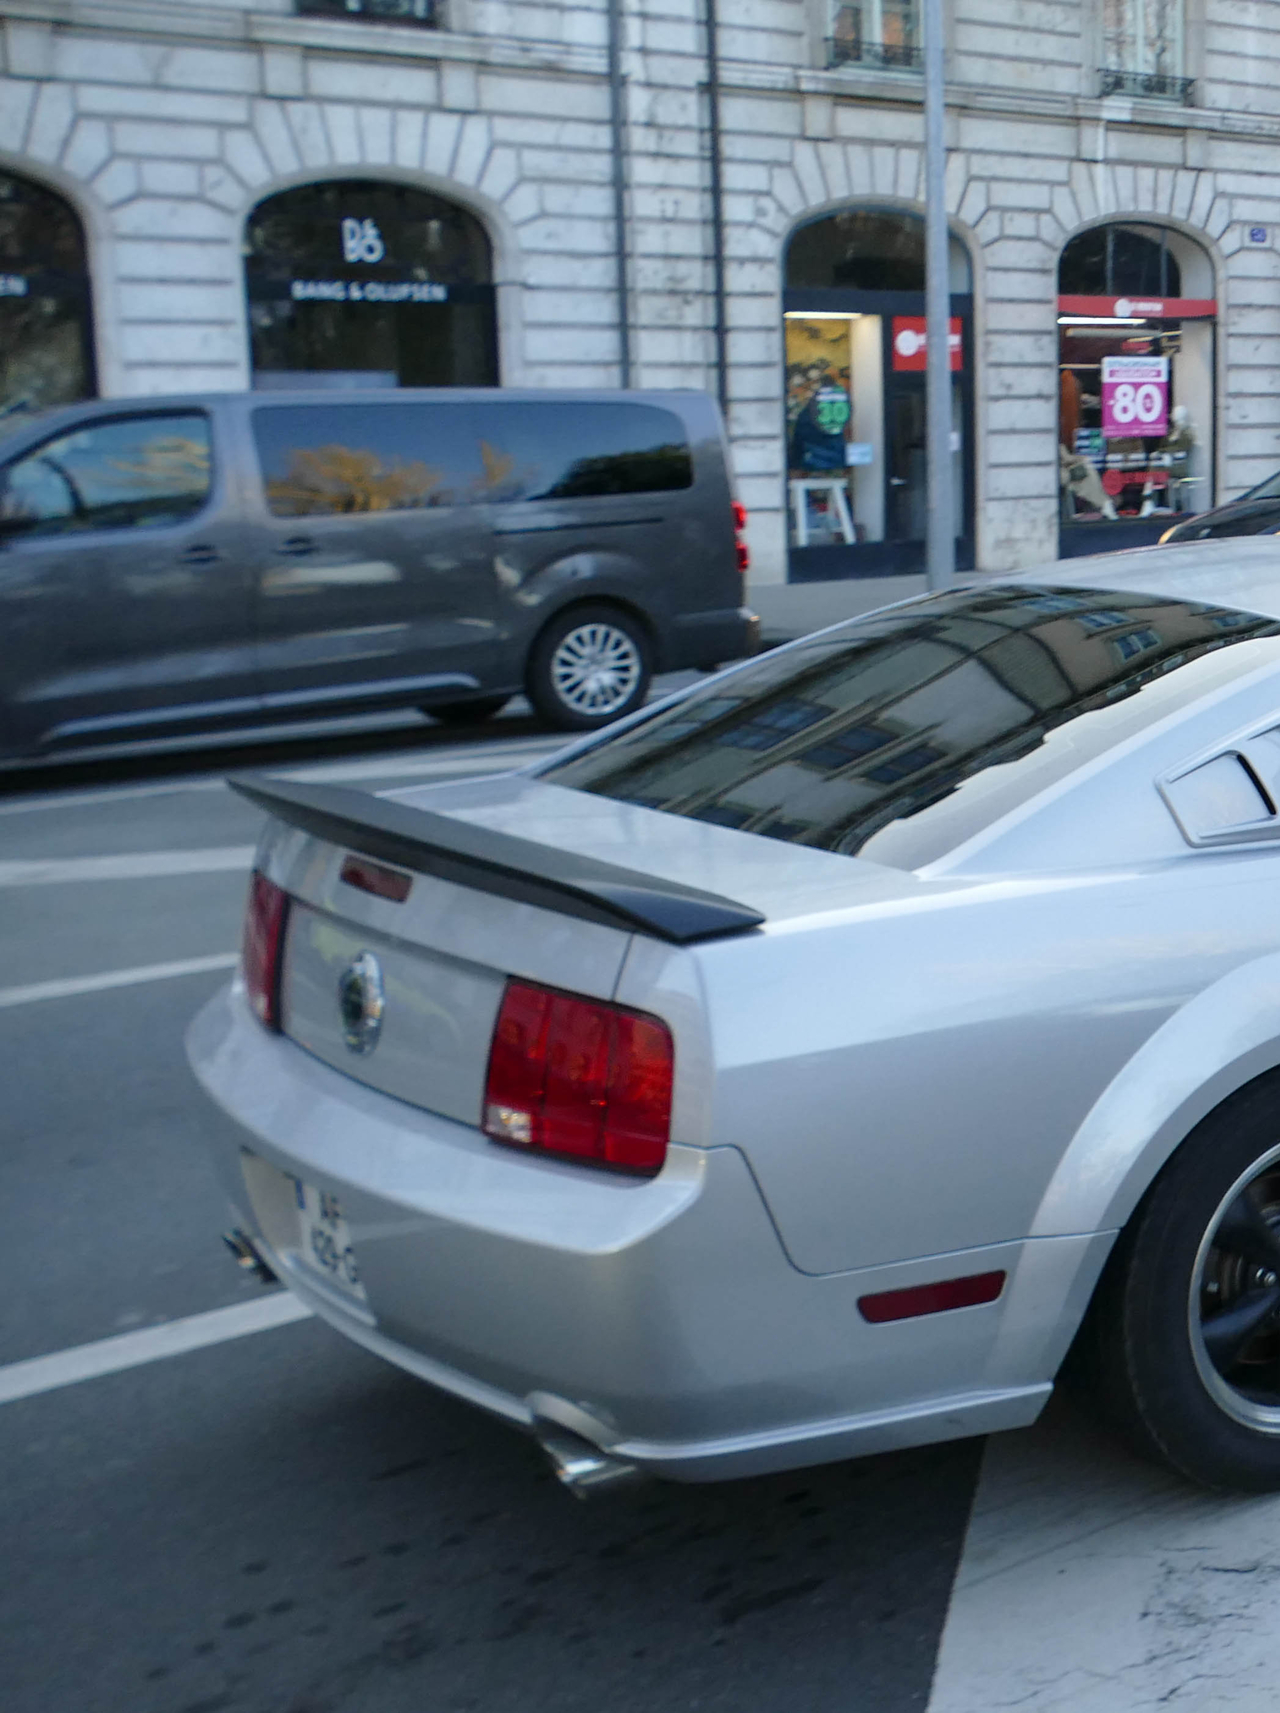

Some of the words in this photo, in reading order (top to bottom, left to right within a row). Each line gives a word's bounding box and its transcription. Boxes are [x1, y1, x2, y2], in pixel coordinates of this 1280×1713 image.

[291, 280, 346, 300] BANG
[349, 281, 363, 300] &
[364, 281, 447, 301] OLUFSEN
